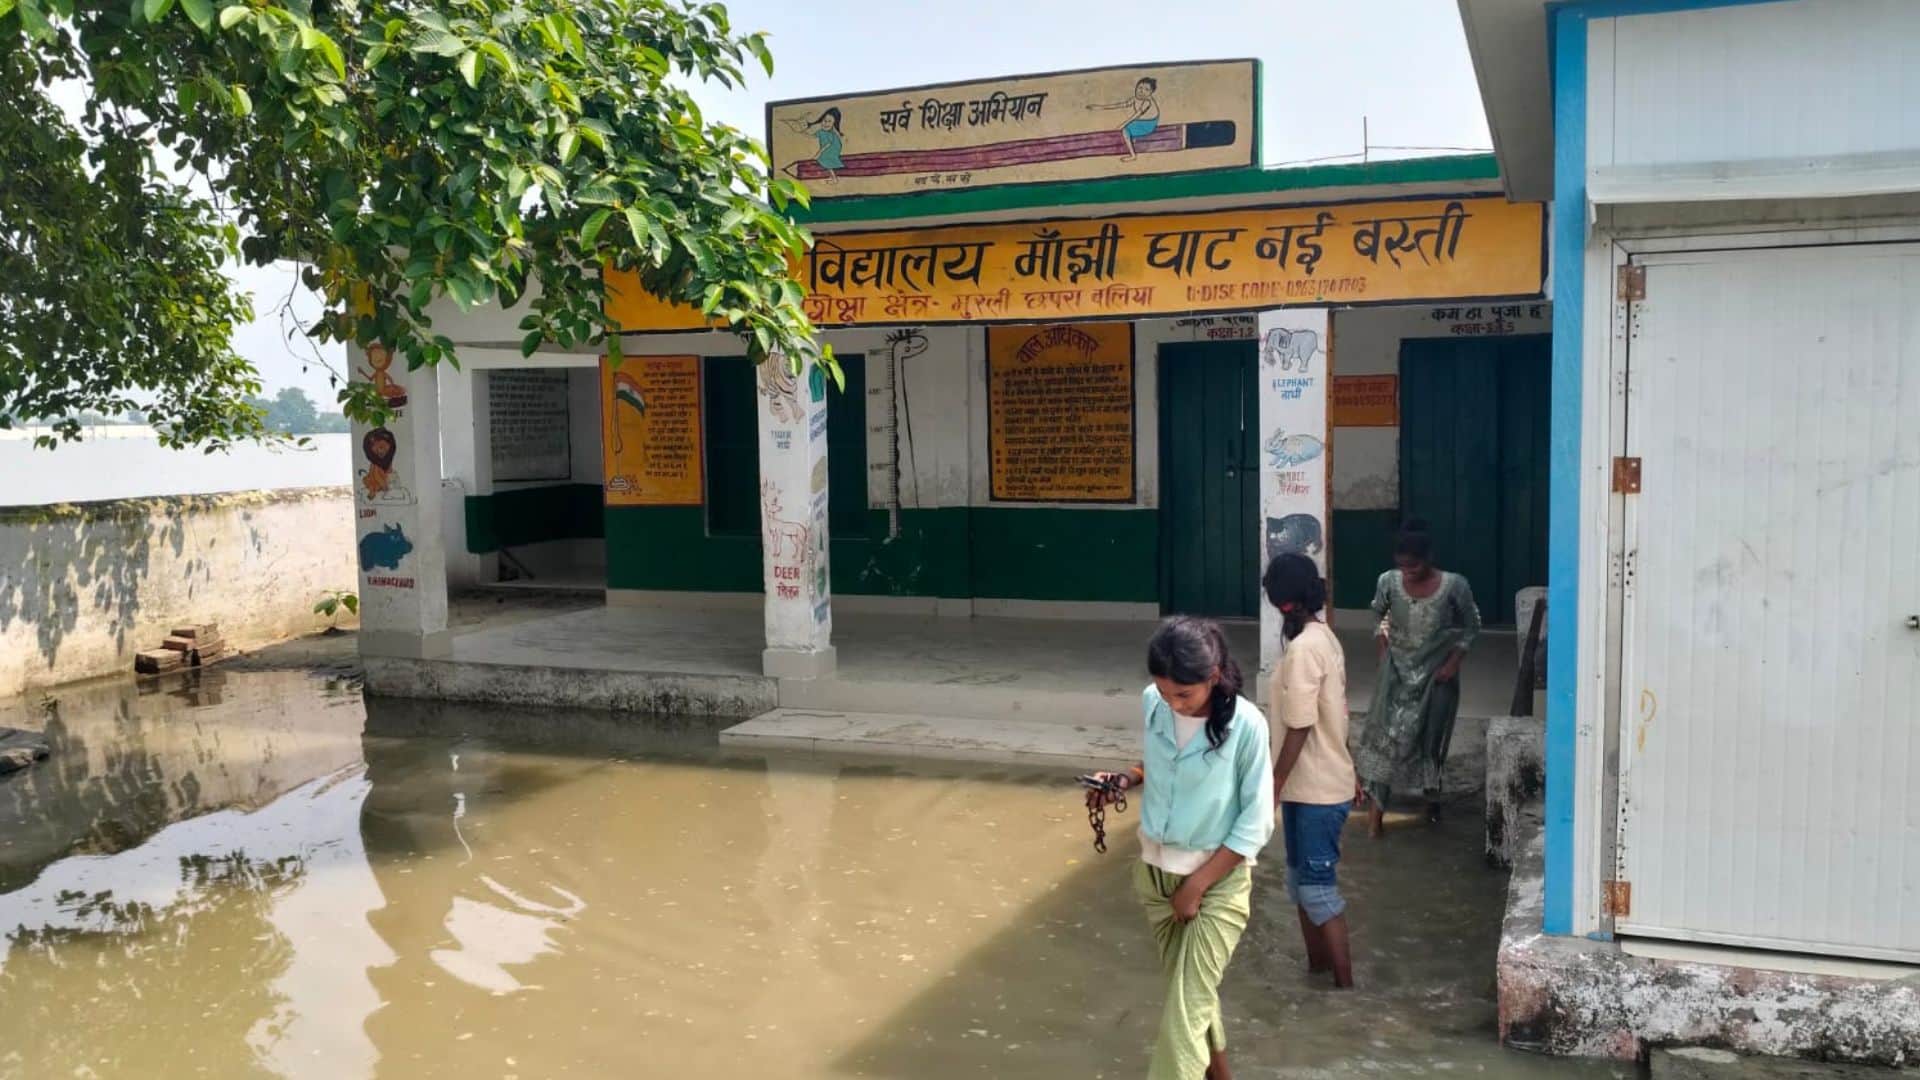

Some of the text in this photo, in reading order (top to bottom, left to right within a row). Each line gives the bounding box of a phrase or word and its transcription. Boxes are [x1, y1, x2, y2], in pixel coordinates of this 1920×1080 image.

[880, 91, 1048, 133] सर्व शिक्षा अभियान
[804, 201, 1473, 293] विद्यालय माँझी घाट नई बस्ती
[360, 509, 377, 518] LION
[774, 566, 800, 580] DEER
